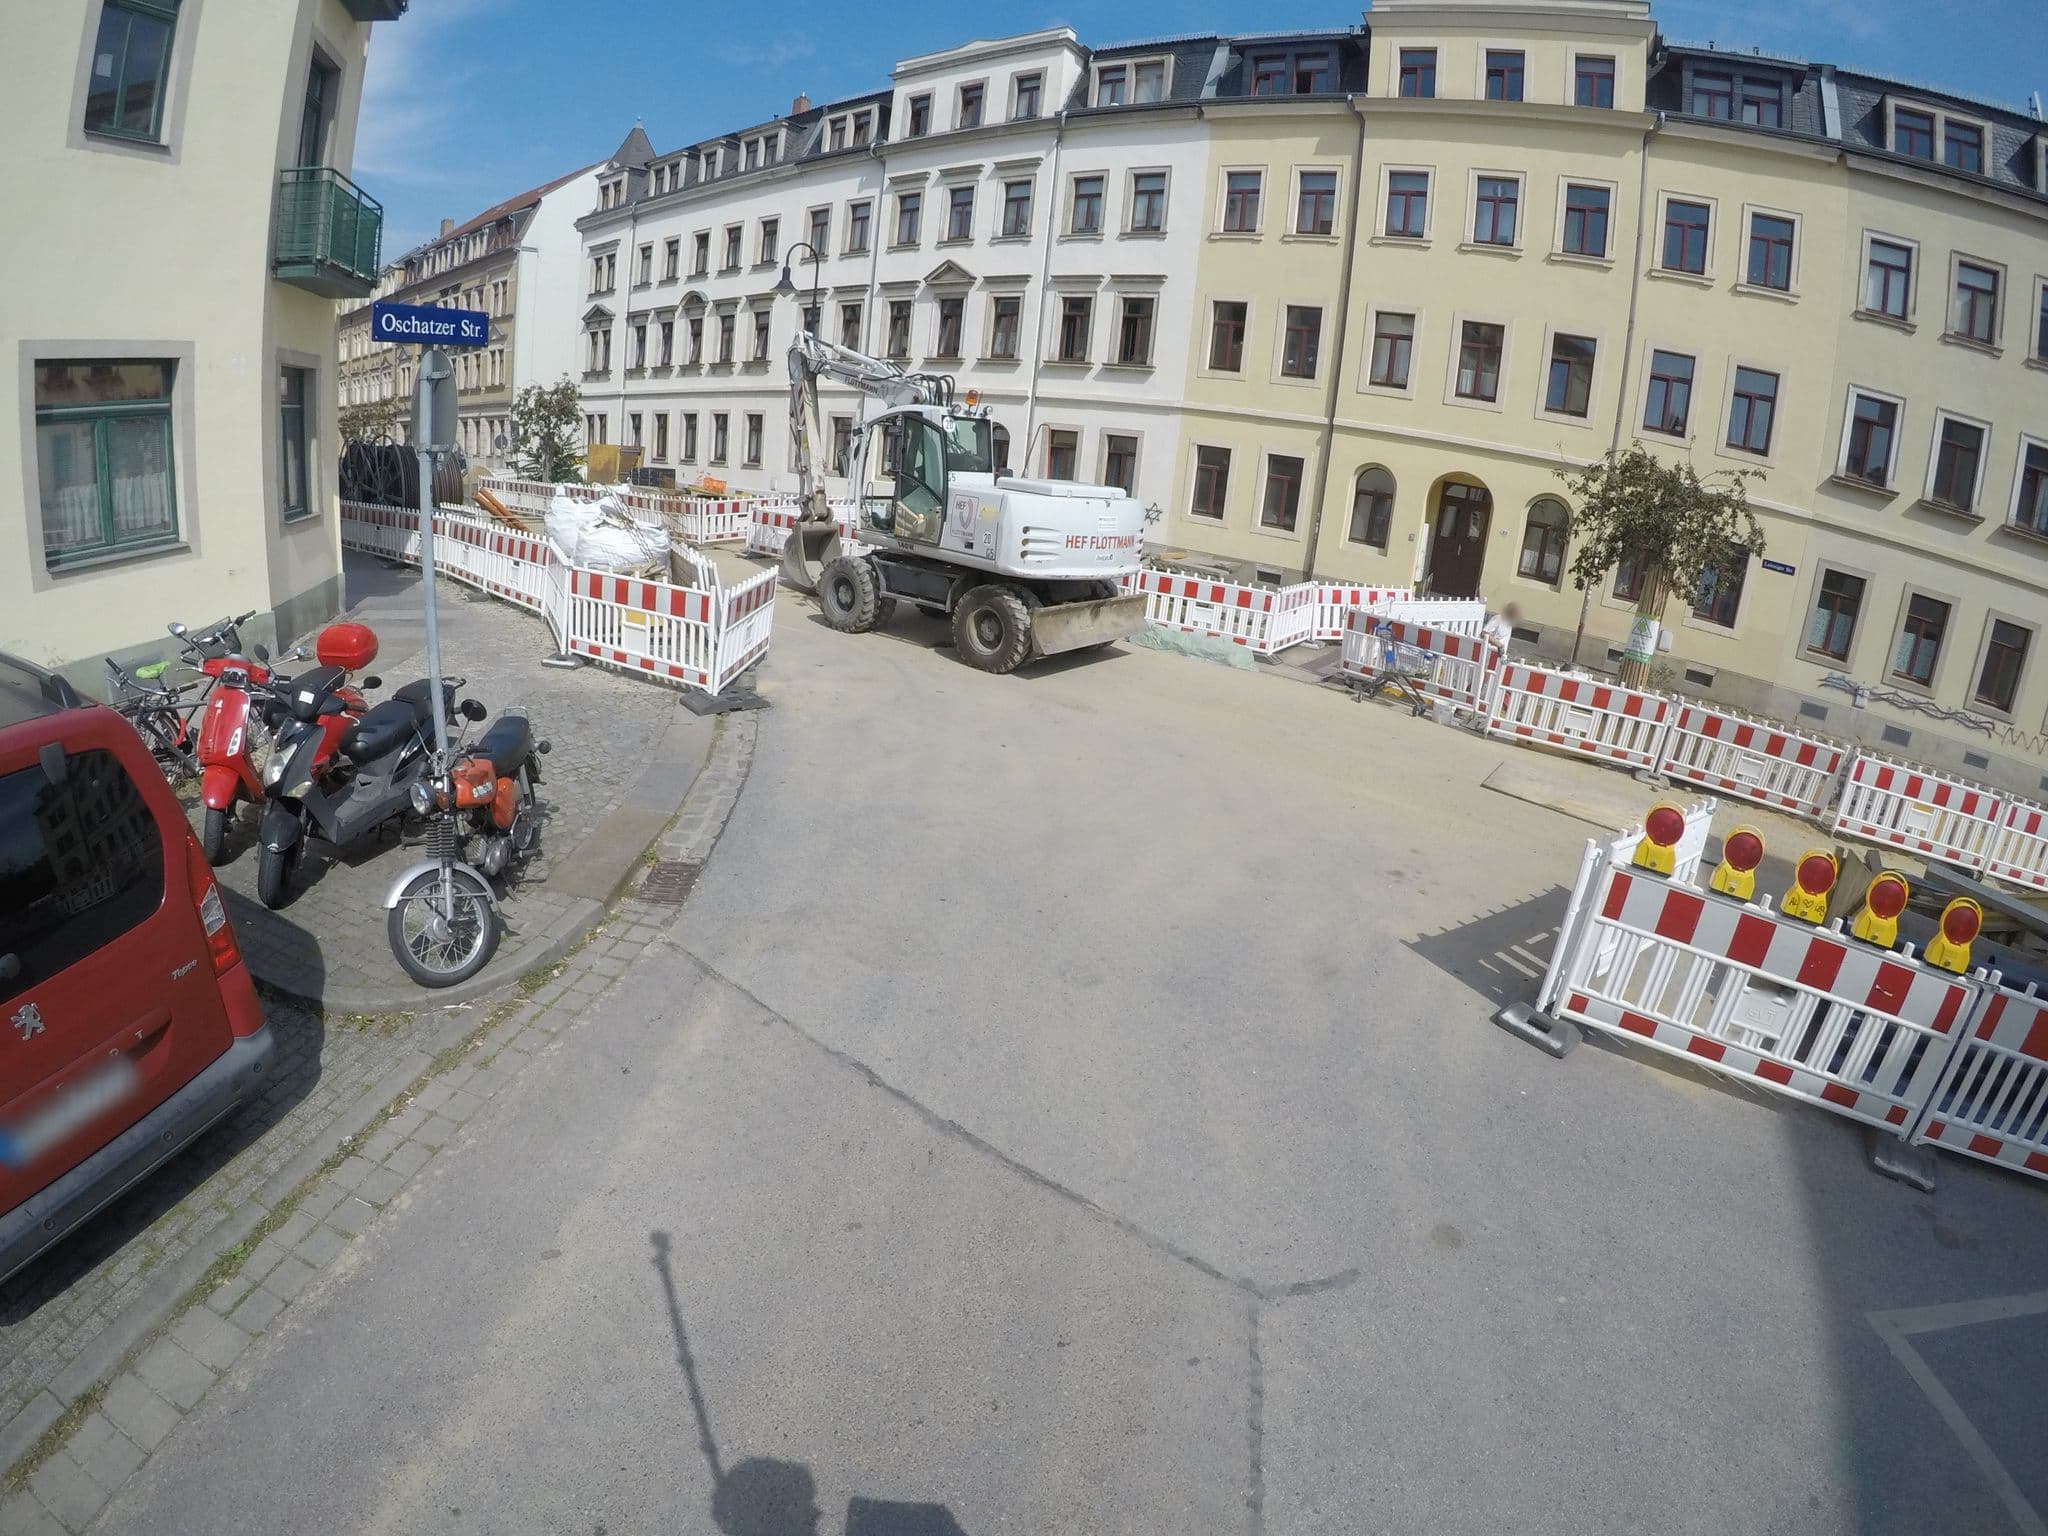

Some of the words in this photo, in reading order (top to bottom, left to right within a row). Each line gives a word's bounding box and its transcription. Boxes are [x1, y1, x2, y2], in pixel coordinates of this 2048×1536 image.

[381, 313, 456, 336] Oschatzer
[460, 319, 484, 338] Str.
[945, 418, 954, 430] 20
[983, 532, 992, 545] 20
[1065, 534, 1089, 550] HEF
[1089, 534, 1135, 550] FLOTTMANN
